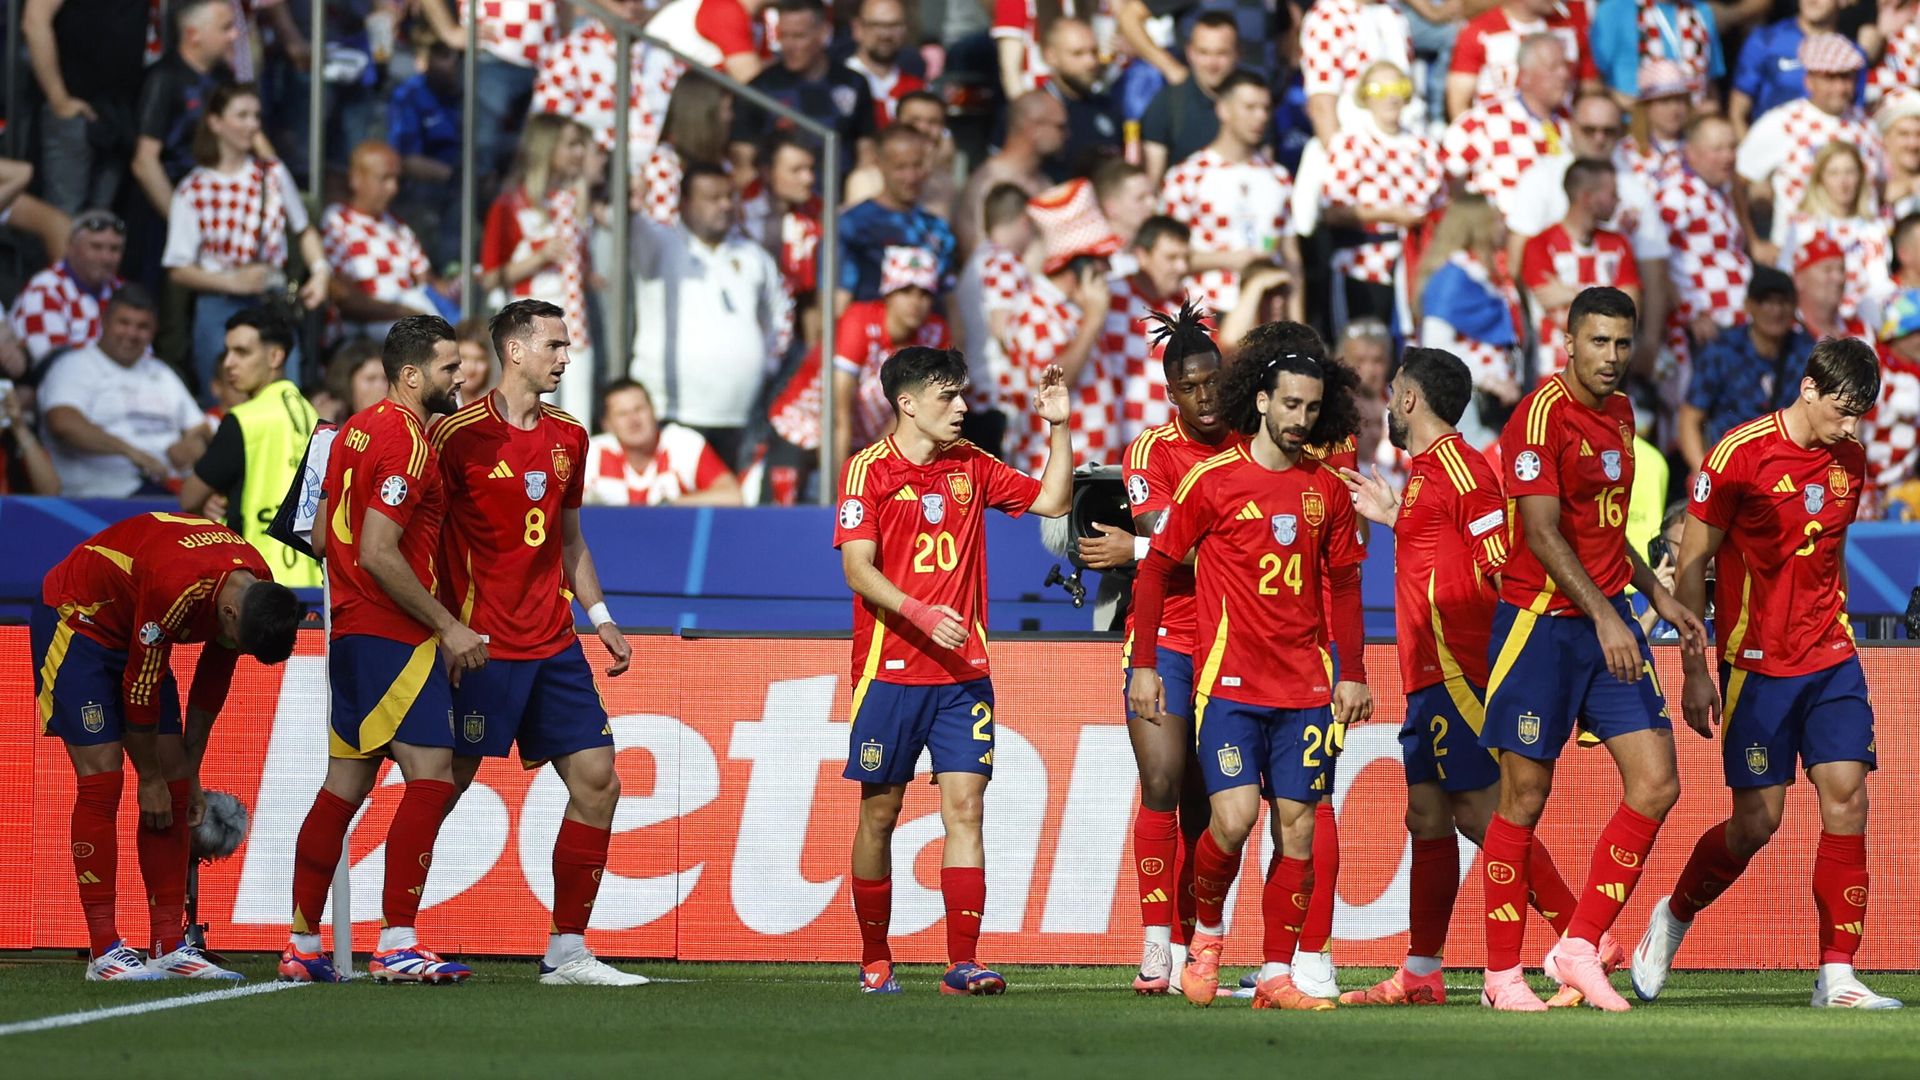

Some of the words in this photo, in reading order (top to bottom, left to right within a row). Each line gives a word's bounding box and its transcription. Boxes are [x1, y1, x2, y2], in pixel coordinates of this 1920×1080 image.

[524, 507, 547, 548] 8
[1594, 487, 1625, 528] 16
[177, 531, 247, 549] MORATA
[913, 530, 959, 574] 20
[1258, 552, 1303, 596] 24
[1429, 714, 1449, 757] 2
